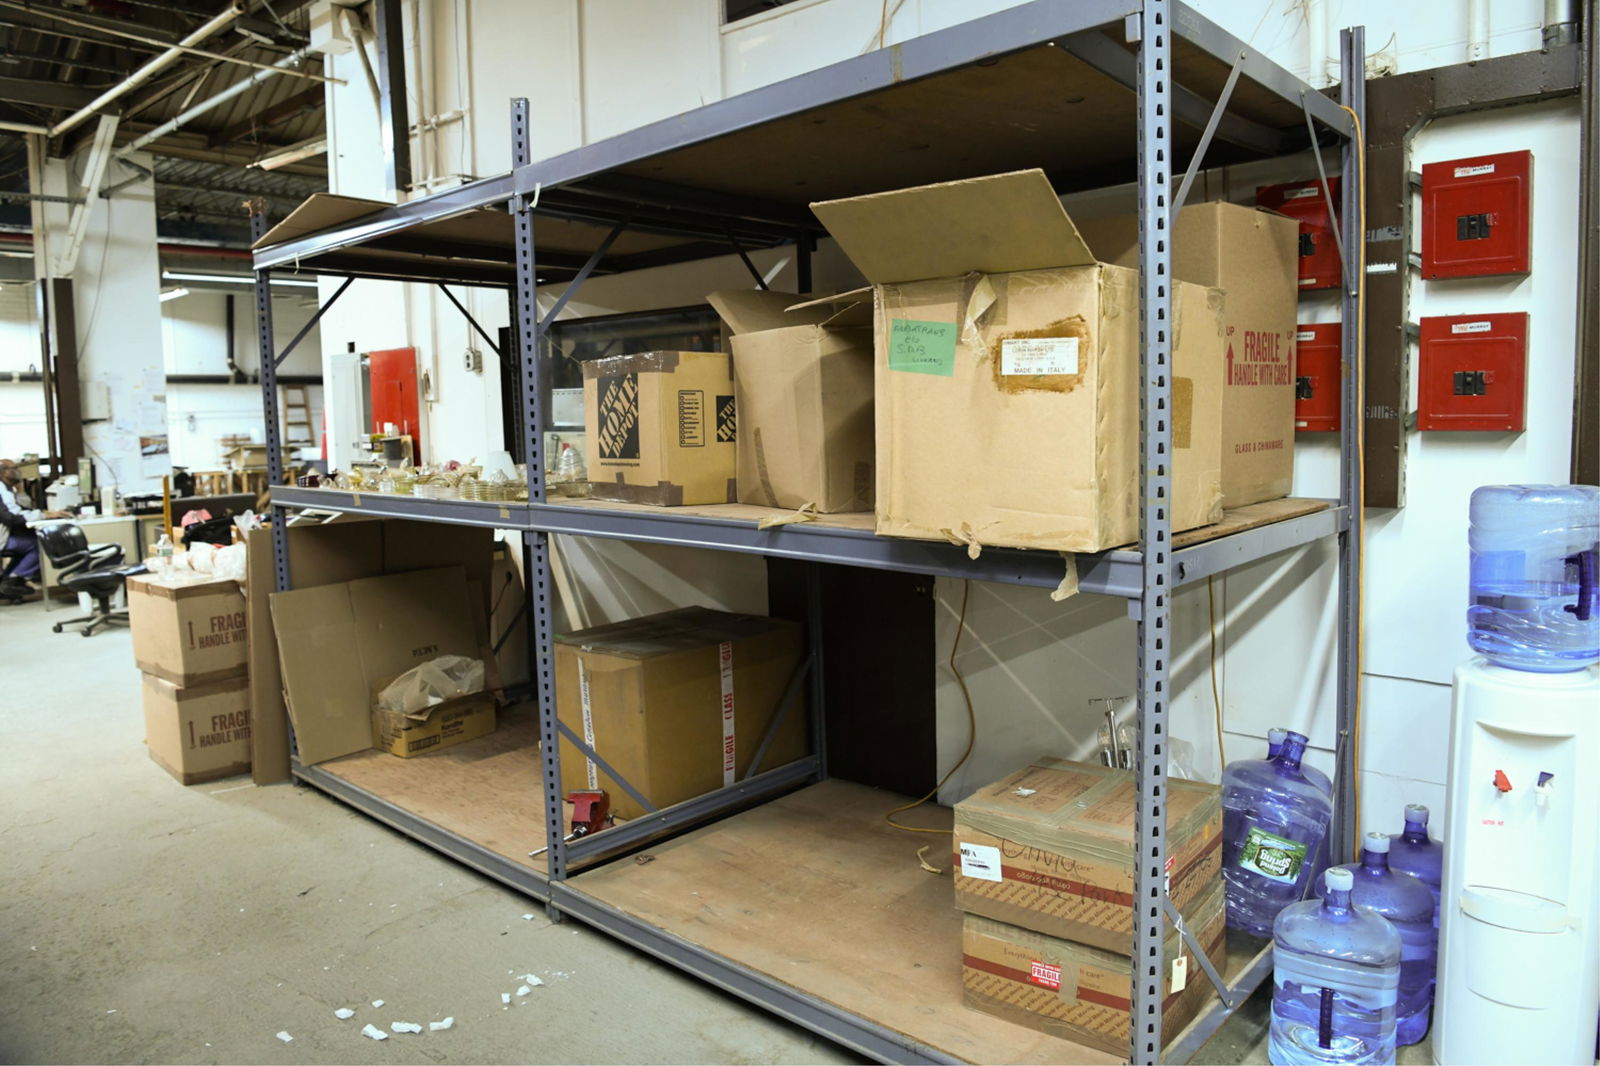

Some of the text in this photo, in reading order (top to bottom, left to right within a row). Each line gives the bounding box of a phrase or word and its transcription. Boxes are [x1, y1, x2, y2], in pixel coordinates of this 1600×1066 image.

[1226, 326, 1235, 336] UP
[1244, 331, 1281, 362] FRAGILE
[1234, 363, 1287, 386] HANDLE WITH CARE
[600, 383, 618, 417] THE
[599, 374, 638, 457] HOME
[612, 401, 638, 458] DEPOT
[1235, 442, 1252, 454] GLASS
[1257, 440, 1284, 451] CHINAWARE
[198, 631, 231, 649] HANDLE
[199, 729, 233, 748] HANDLE
[1260, 849, 1292, 869] Spring
